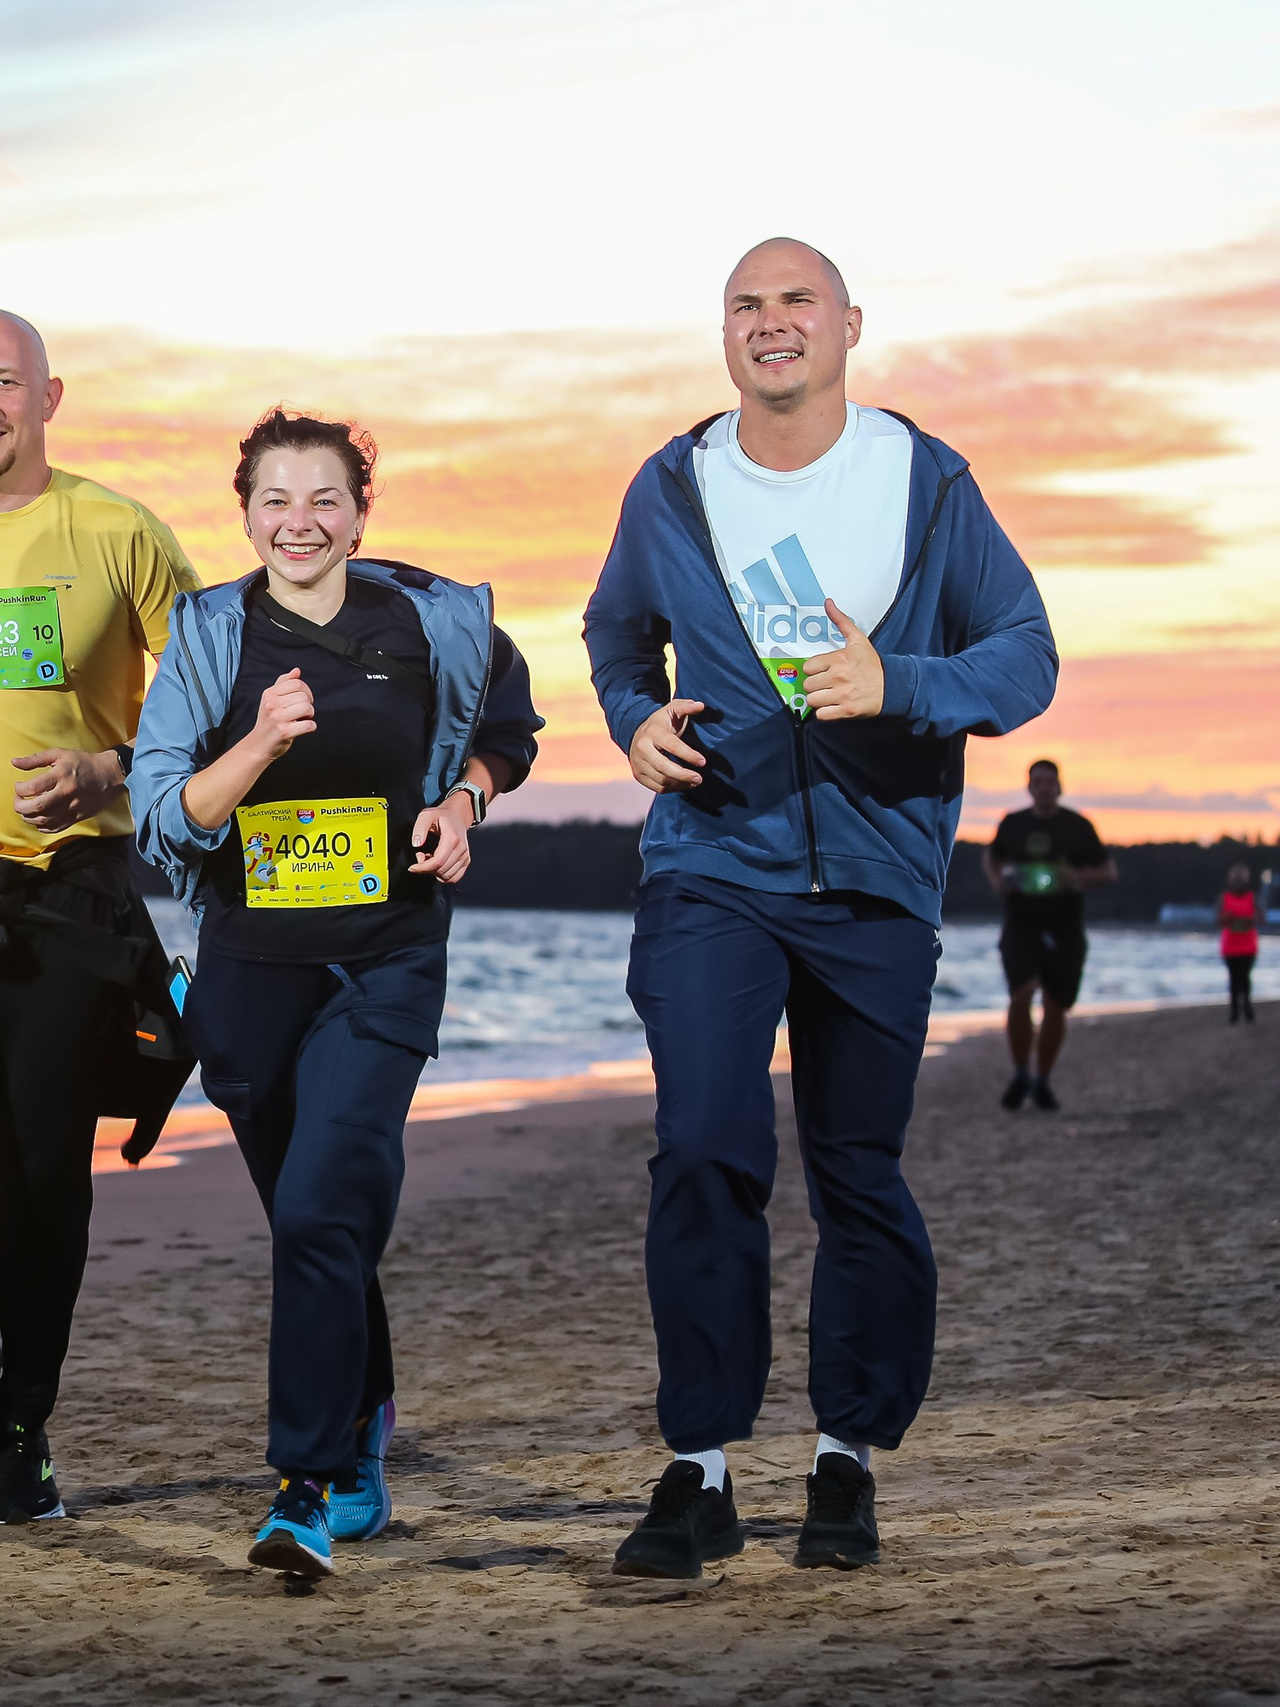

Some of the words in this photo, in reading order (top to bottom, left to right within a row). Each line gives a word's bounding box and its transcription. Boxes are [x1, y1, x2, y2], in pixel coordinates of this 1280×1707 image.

[32, 624, 54, 641] 10
[41, 664, 55, 679] D
[247, 807, 292, 818] БАЛТИЙСКИЙ
[320, 805, 374, 815] PushkinRun
[271, 814, 292, 822] ТРЕЙЛ
[275, 832, 351, 859] 4040
[365, 837, 373, 853] 1
[292, 861, 335, 873] ИРИНА
[362, 877, 377, 893] D
